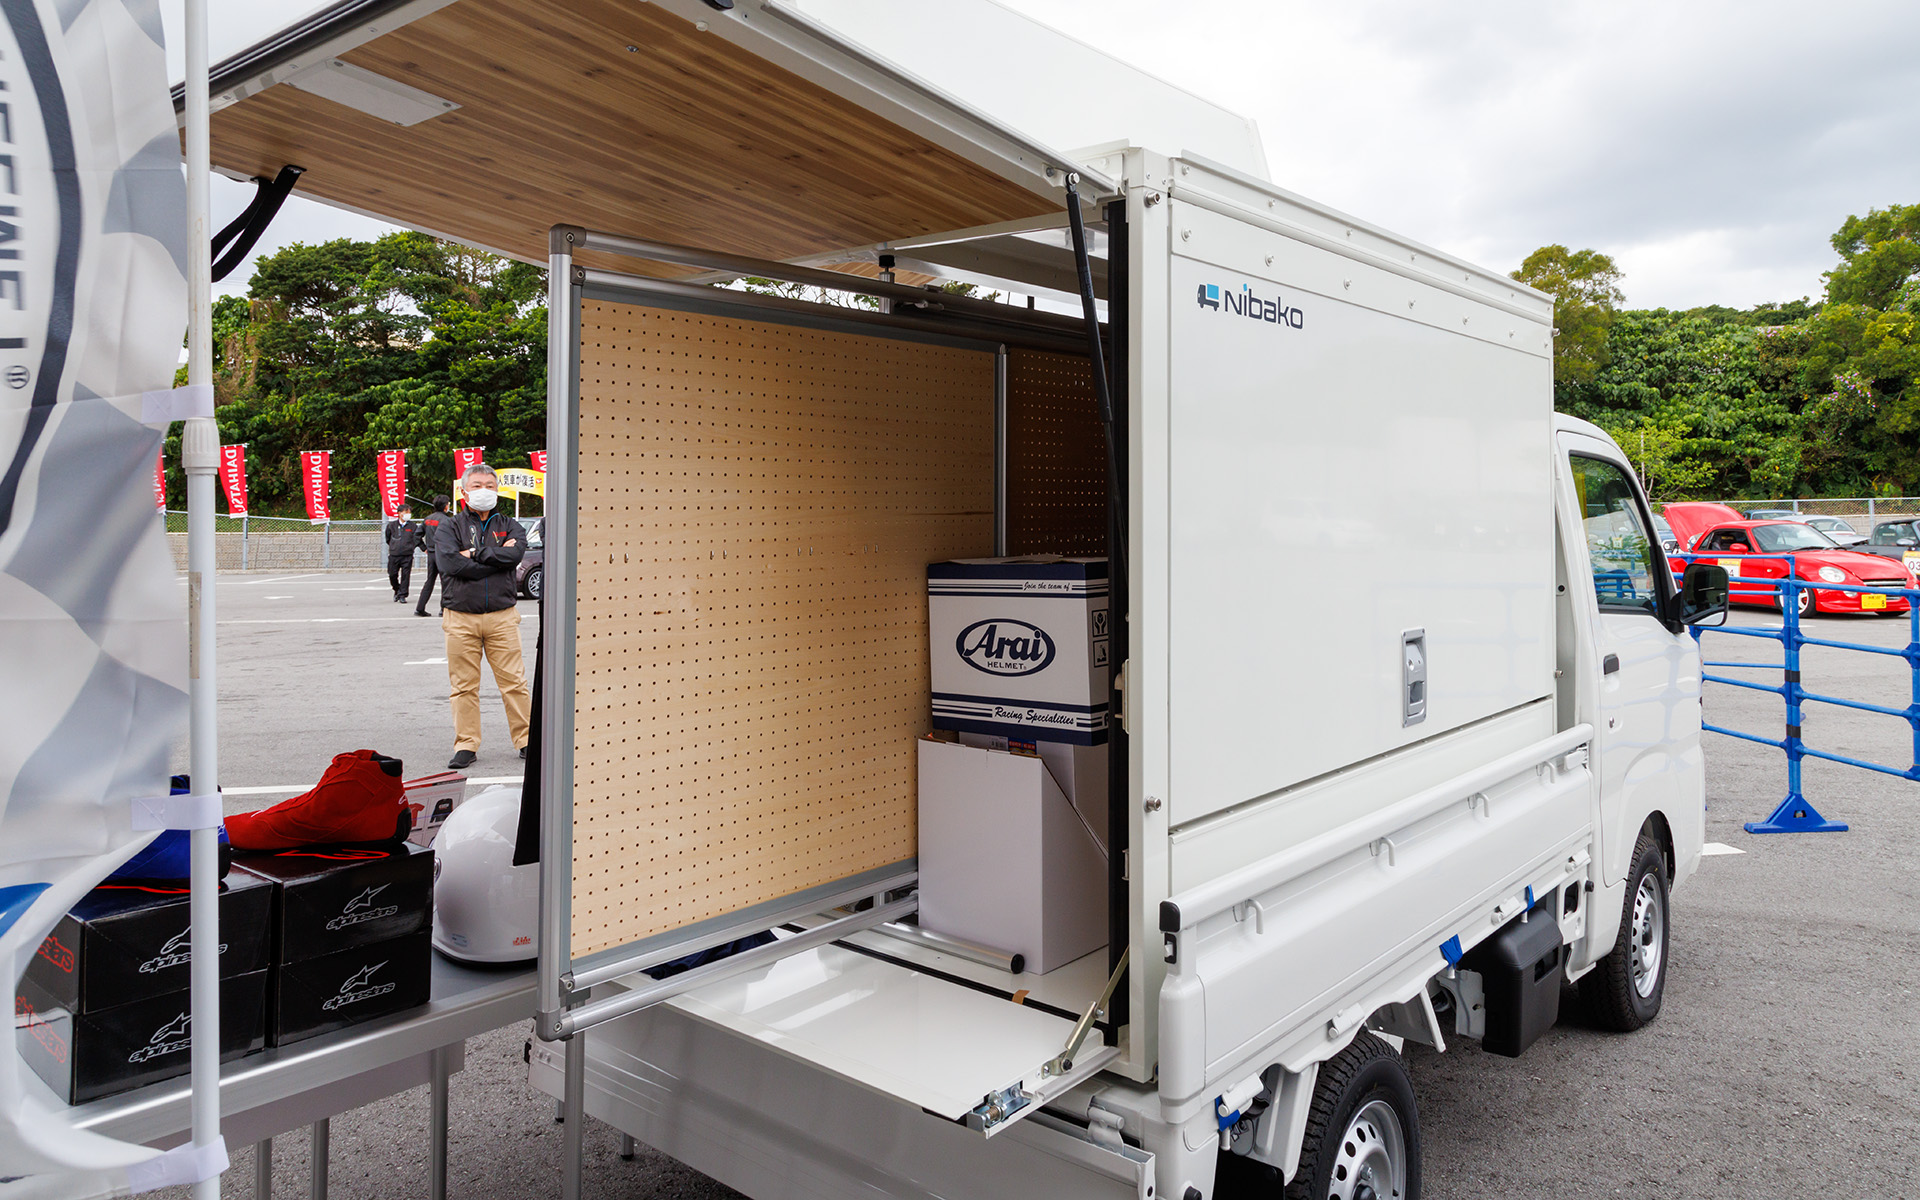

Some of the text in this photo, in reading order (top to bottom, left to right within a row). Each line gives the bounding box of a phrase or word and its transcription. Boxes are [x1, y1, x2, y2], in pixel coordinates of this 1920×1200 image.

[1224, 283, 1303, 330] Nibako
[1023, 581, 1037, 590] Join
[1063, 582, 1071, 591] of
[962, 624, 1044, 662] Arai
[987, 661, 1024, 670] HELMET
[994, 706, 1075, 726] Racing Specialities
[326, 905, 398, 930] alpinestars
[322, 982, 396, 1010] alpinestars
